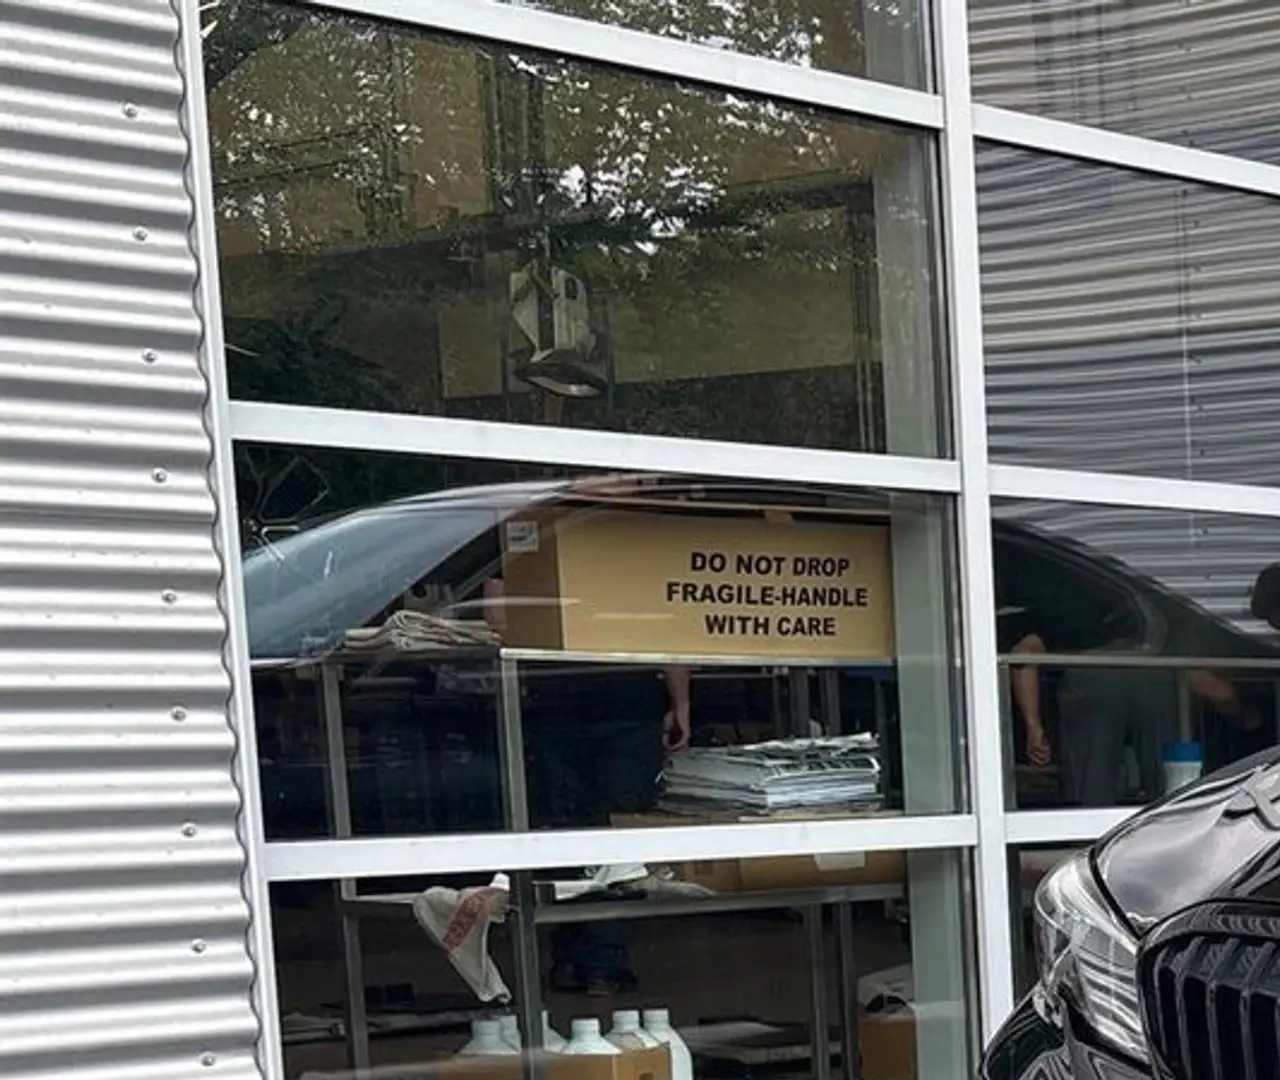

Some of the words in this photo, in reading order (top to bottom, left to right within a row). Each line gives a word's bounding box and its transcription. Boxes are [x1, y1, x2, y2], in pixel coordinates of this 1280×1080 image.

[691, 552, 726, 573] DO
[736, 554, 786, 576] NOT
[792, 556, 850, 578] DROP
[666, 581, 869, 608] FRAGILE-HANDLE
[704, 614, 770, 636] WITH
[776, 616, 837, 637] CARE
